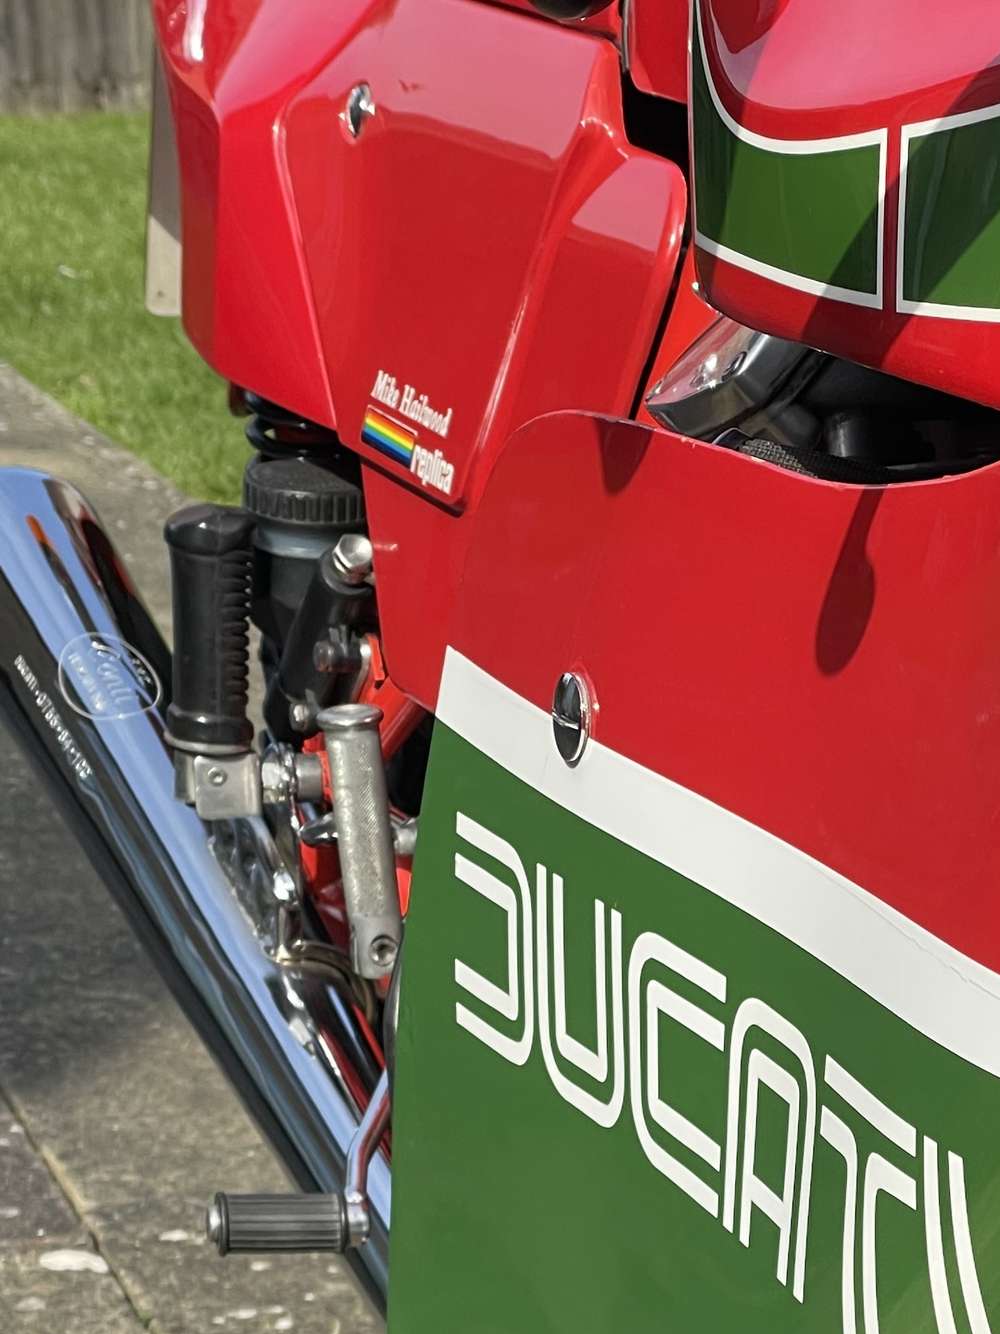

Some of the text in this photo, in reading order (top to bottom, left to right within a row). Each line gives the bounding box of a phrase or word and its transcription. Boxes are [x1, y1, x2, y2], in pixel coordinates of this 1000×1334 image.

[370, 369, 453, 440] Mike Hailwood
[410, 444, 455, 496] replica
